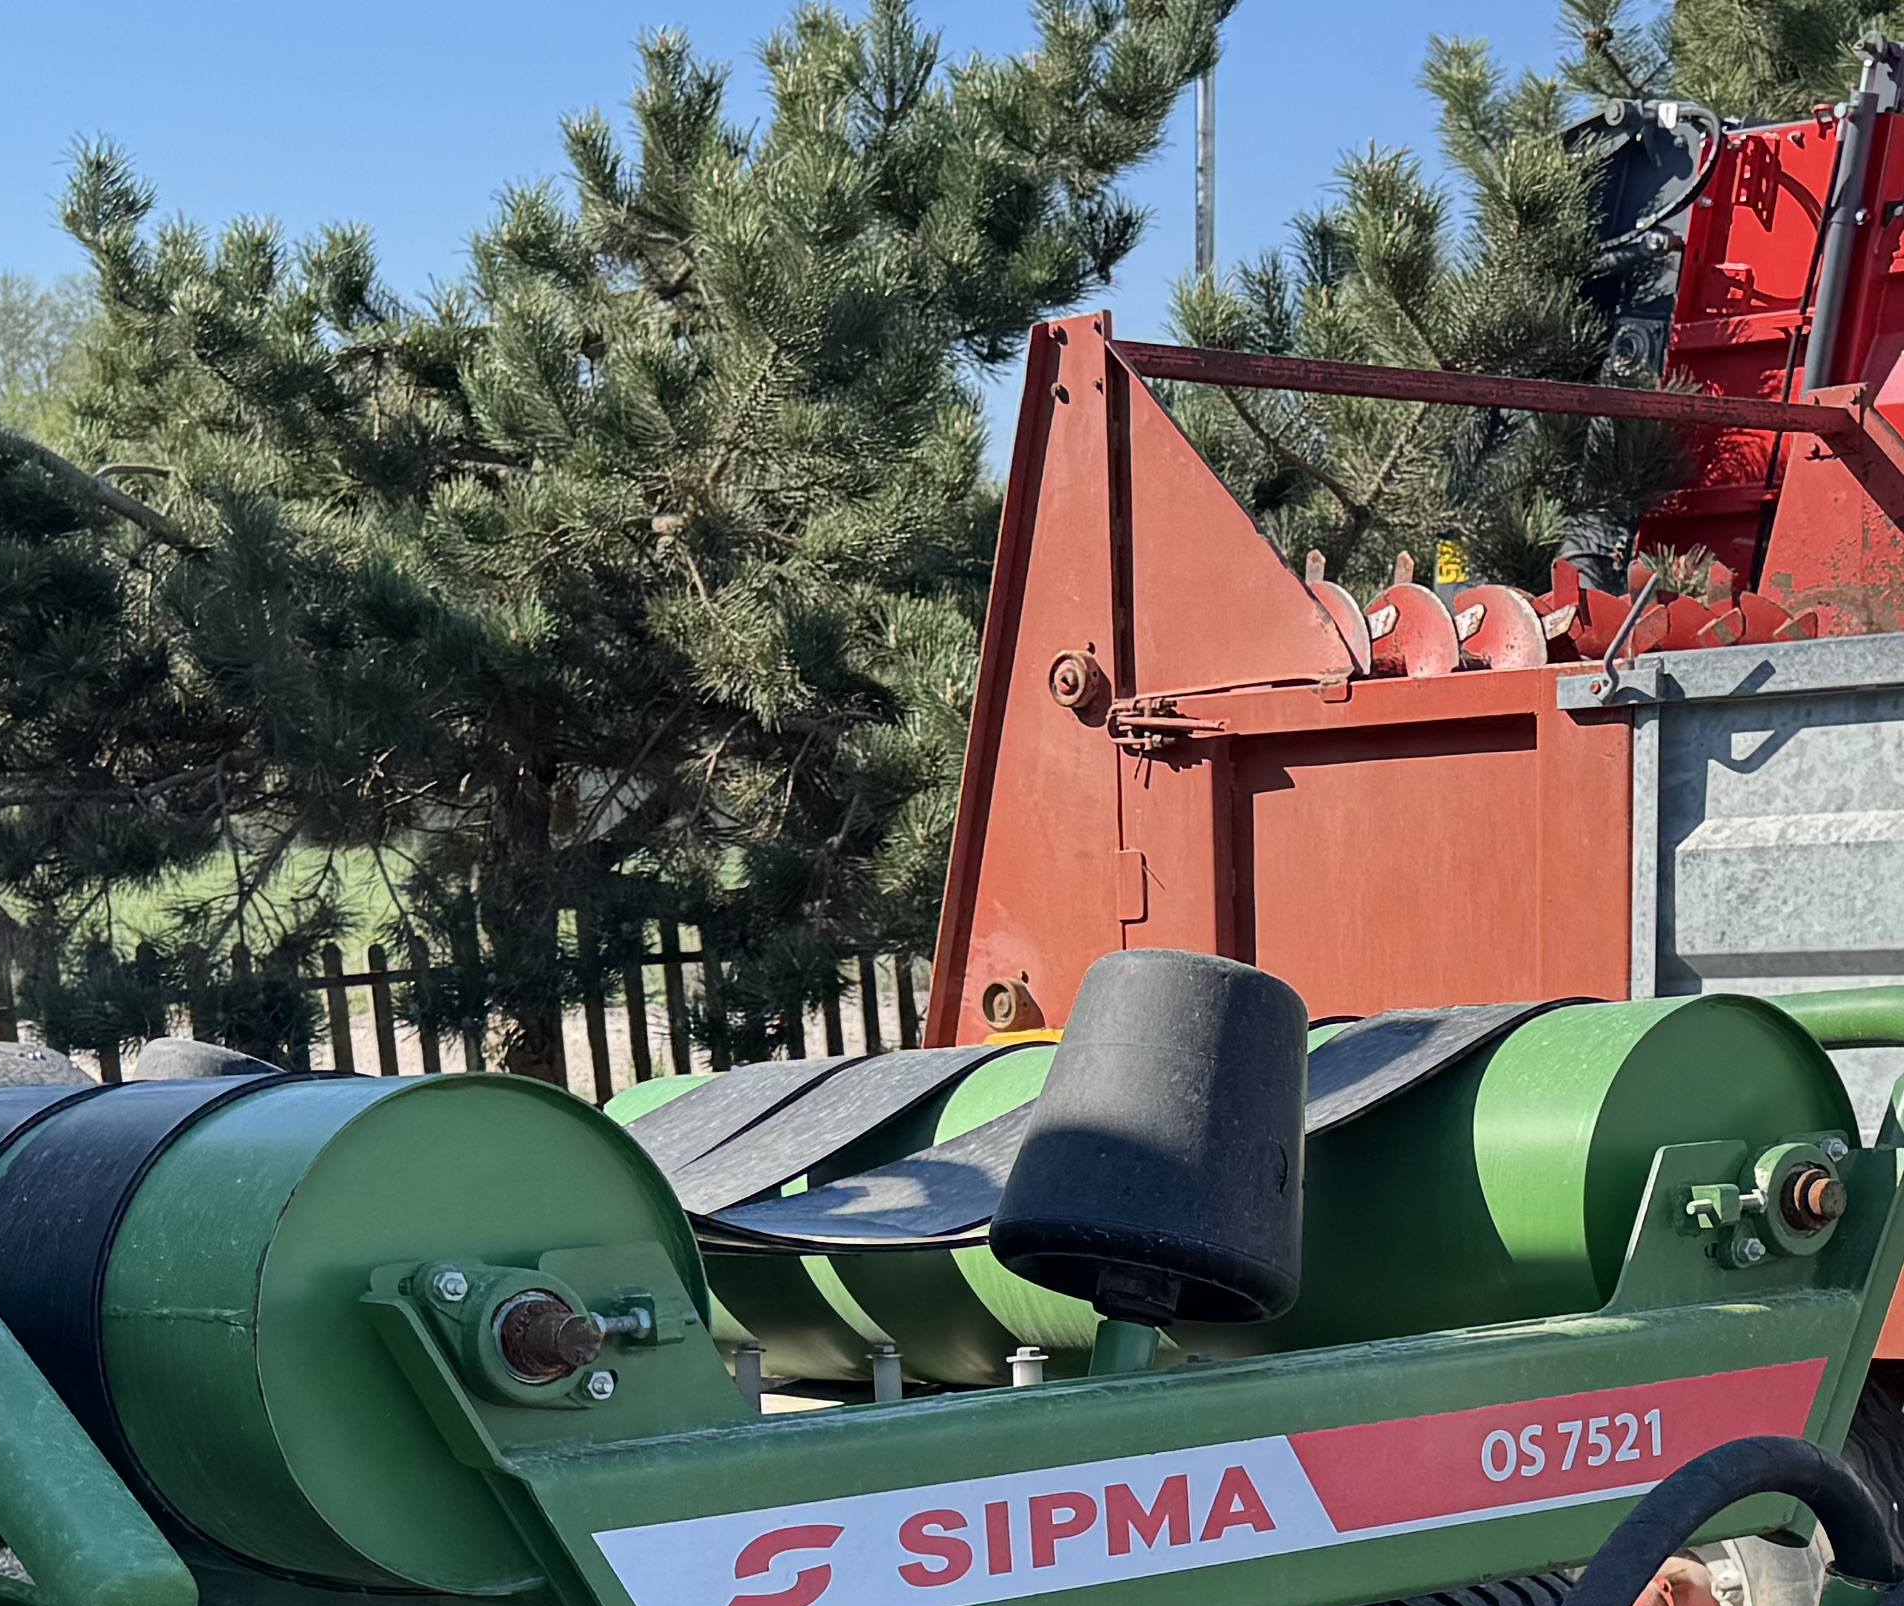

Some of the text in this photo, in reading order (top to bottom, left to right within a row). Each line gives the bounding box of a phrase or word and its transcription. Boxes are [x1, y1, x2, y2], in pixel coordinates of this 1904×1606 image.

[1481, 1408, 1662, 1482] OS 7521
[898, 1465, 1277, 1587] SIPMA
